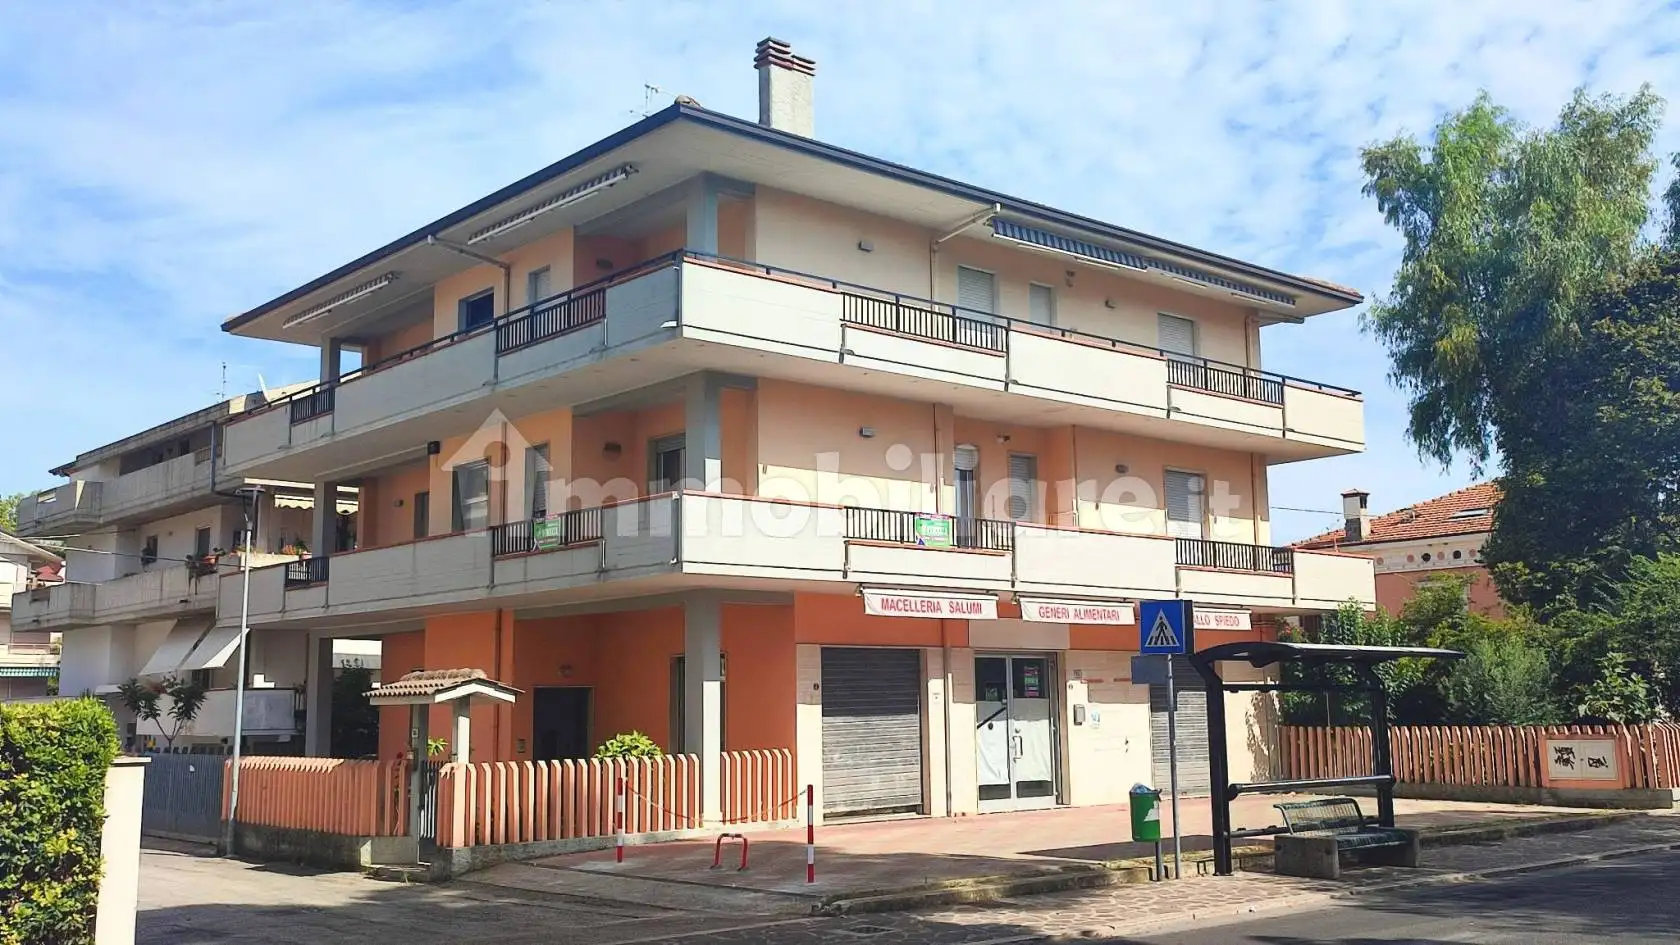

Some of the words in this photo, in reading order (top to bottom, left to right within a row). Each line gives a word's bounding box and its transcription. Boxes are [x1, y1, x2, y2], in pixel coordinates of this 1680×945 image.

[881, 598, 942, 613] MACELLERIA
[949, 601, 982, 614] SALUMI
[1038, 606, 1069, 619] GENERI
[1073, 608, 1120, 621] ALIMENTARI
[1215, 615, 1240, 627] SPIEDO
